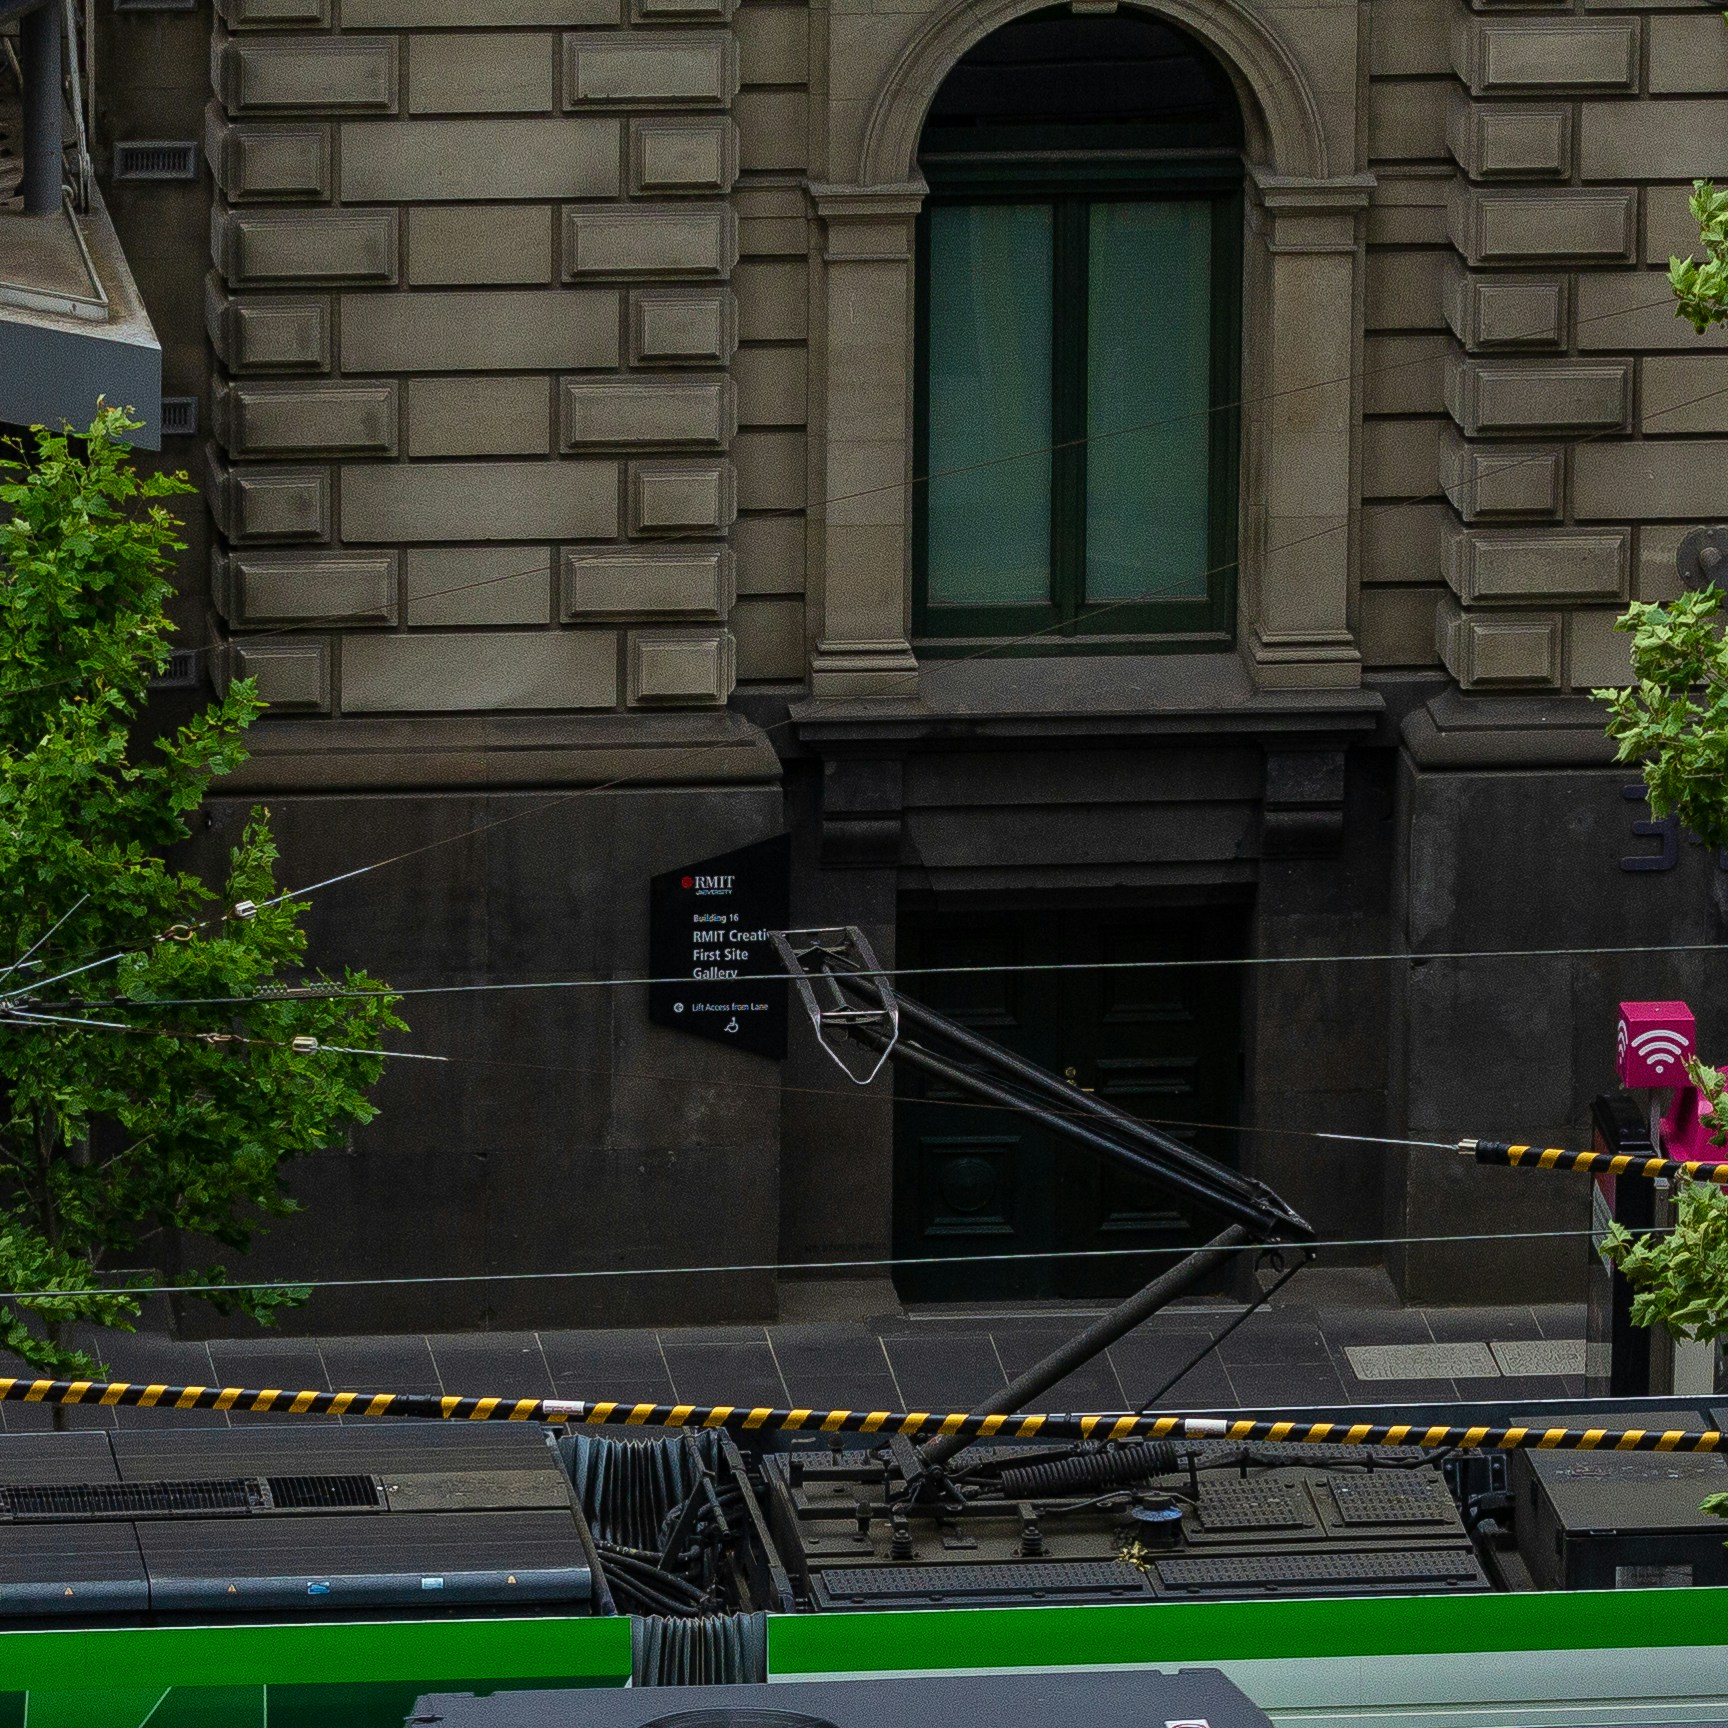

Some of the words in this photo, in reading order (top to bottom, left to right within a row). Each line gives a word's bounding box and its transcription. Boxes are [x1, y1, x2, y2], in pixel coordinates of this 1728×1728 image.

[694, 875, 735, 889] RMIT
[693, 913, 727, 924] Building
[729, 913, 740, 922] 16
[693, 930, 726, 943] RMIT
[693, 948, 721, 961] First
[724, 947, 749, 960] Site
[693, 966, 738, 980] Gallery
[692, 1003, 704, 1012] Lift
[705, 1003, 730, 1012] Access
[731, 1003, 749, 1011] from
[750, 1002, 769, 1011] Lane
